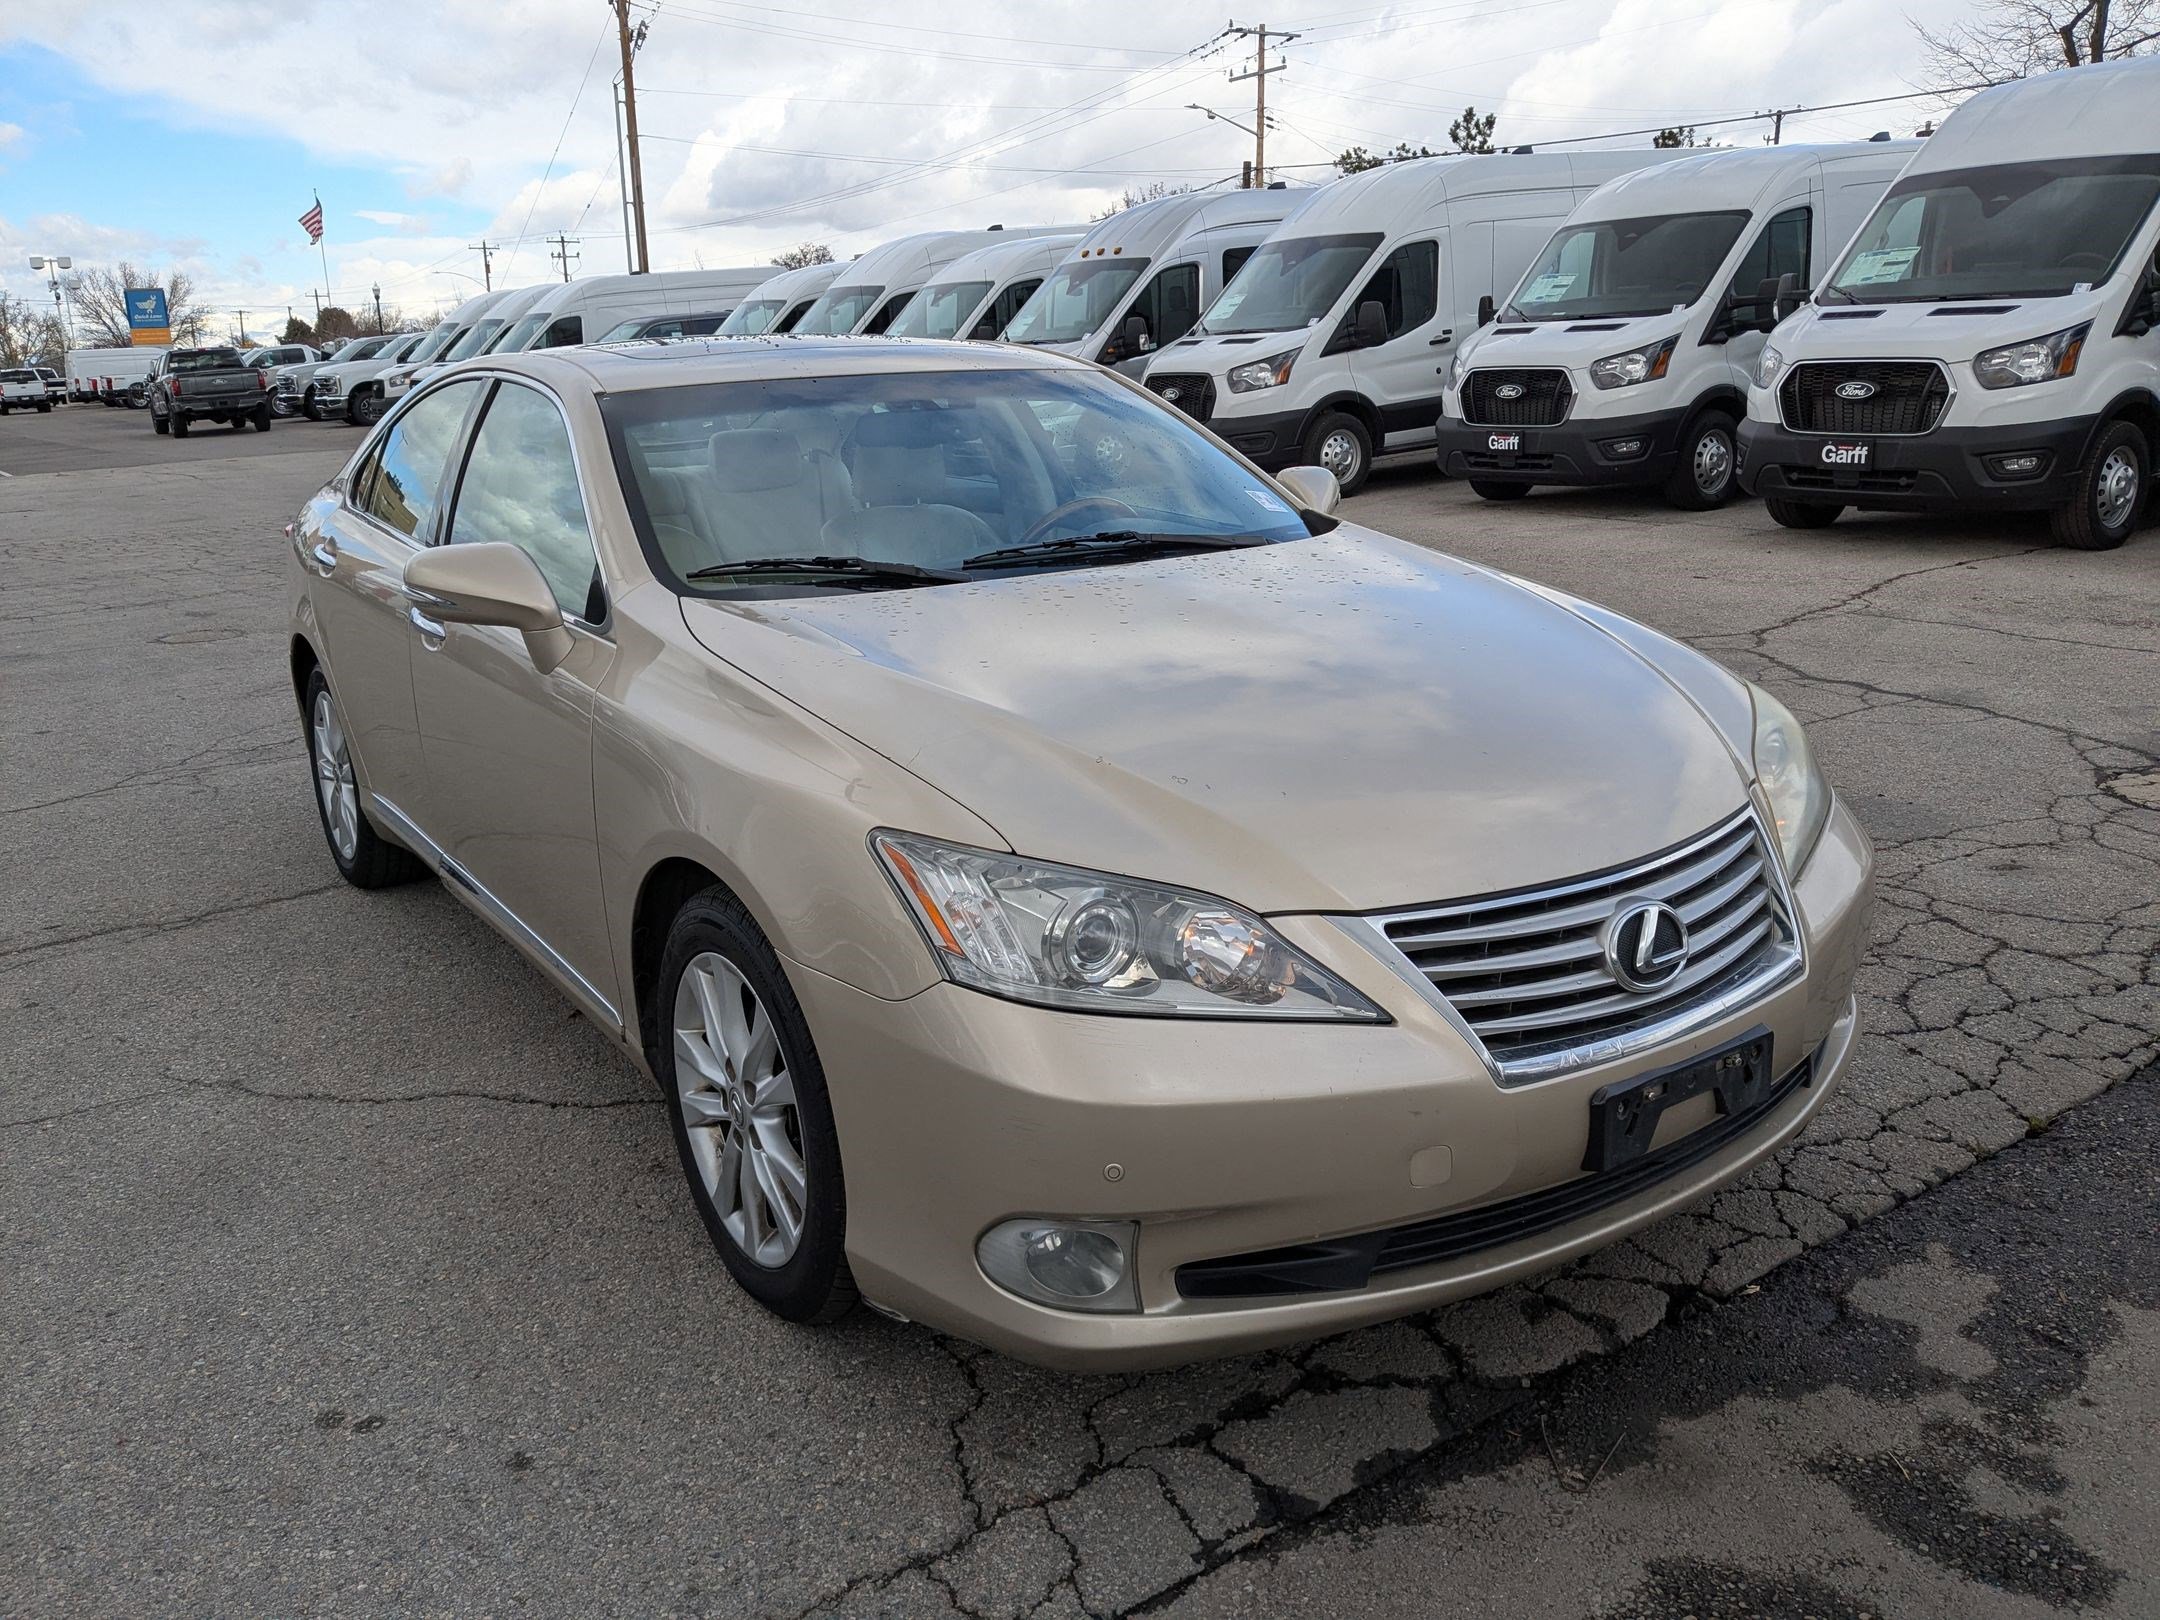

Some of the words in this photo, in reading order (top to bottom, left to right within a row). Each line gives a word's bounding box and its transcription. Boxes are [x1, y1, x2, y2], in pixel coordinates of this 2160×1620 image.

[1500, 387, 1518, 396] Ford
[1841, 384, 1868, 396] Ford
[1488, 435, 1519, 450] Garff
[1821, 444, 1869, 464] Garff
